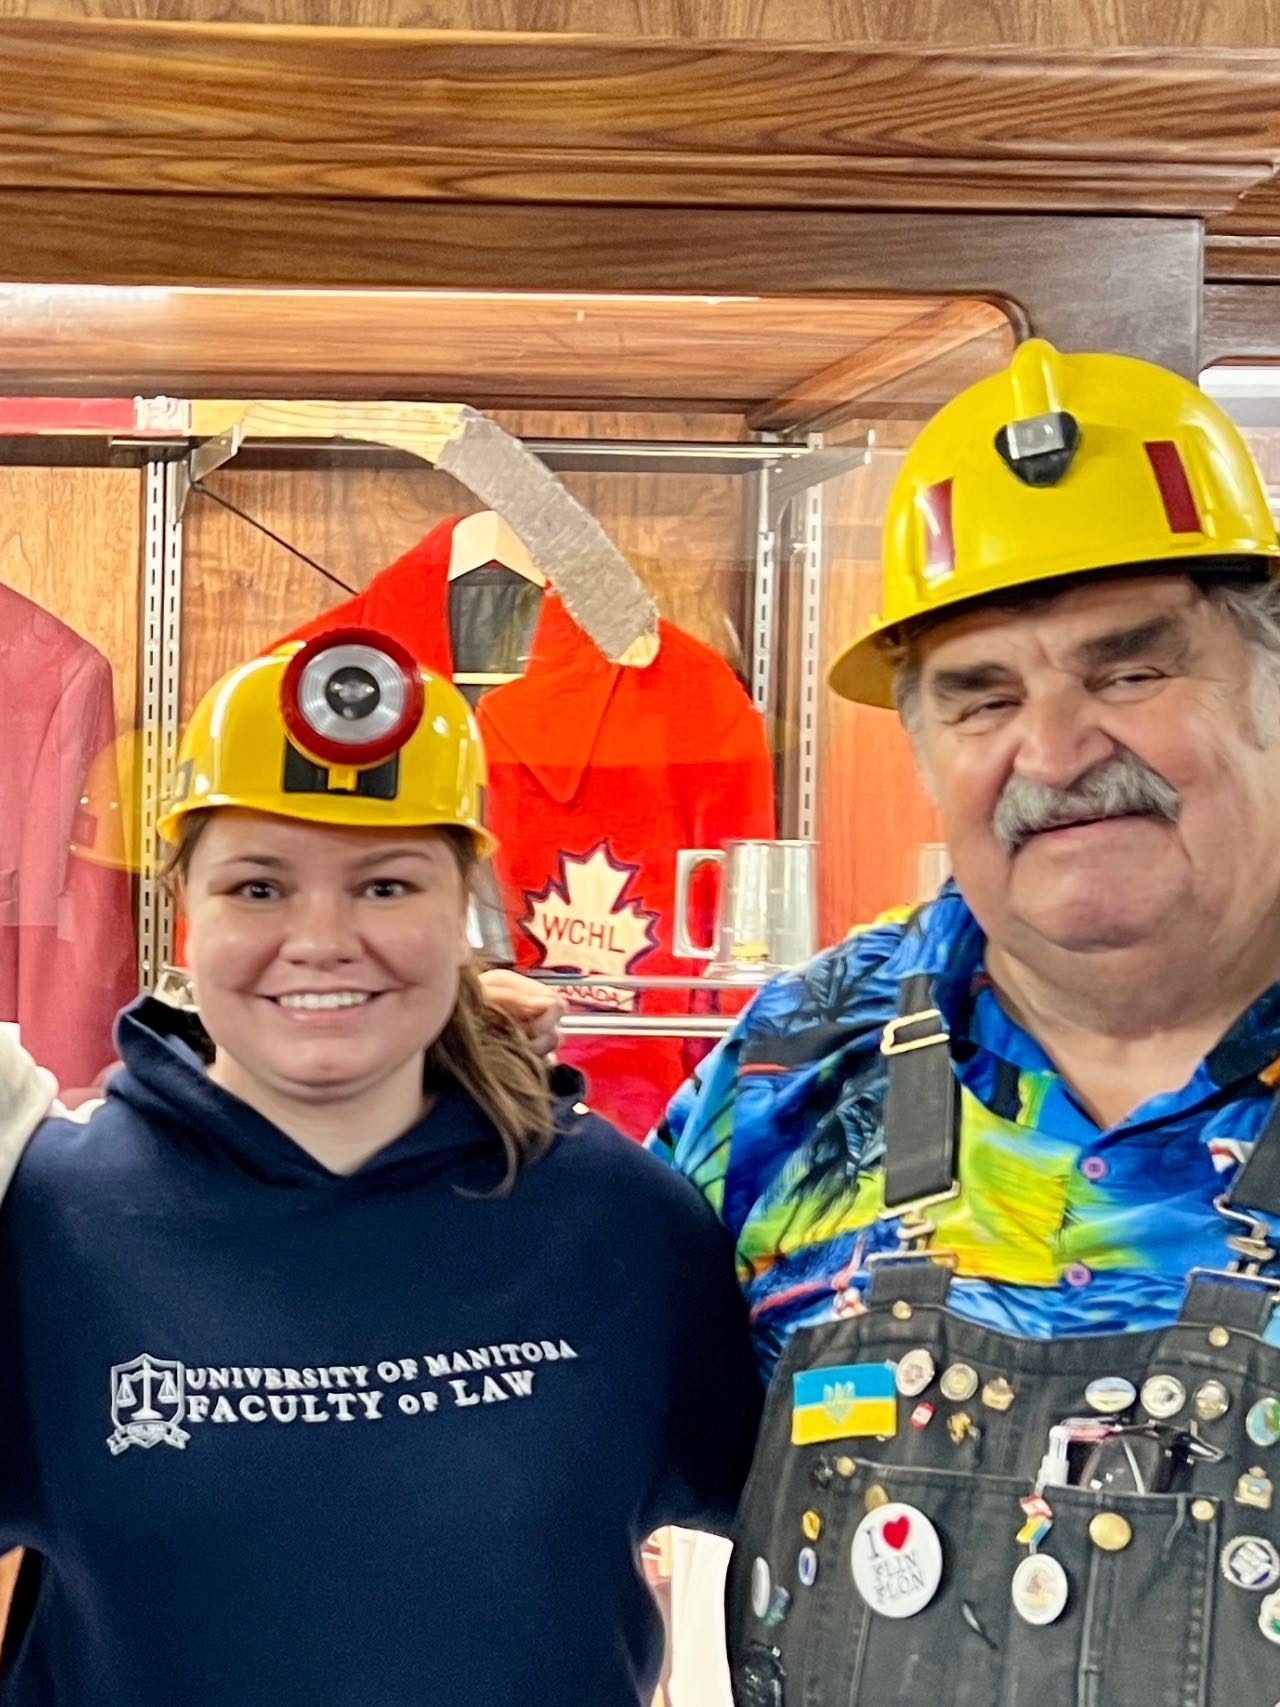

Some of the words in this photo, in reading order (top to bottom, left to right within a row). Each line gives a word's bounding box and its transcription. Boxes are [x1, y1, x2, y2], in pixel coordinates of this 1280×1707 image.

[542, 913, 626, 954] WCHL
[185, 1365, 369, 1392] UNIVERSITY
[377, 1357, 419, 1383] OF
[427, 1339, 579, 1378] MANITOBA
[185, 1390, 383, 1424] FACULTY
[398, 1390, 441, 1415] OF
[450, 1369, 537, 1409] LAW
[863, 1526, 881, 1559] I
[874, 1572, 926, 1604] FLON
